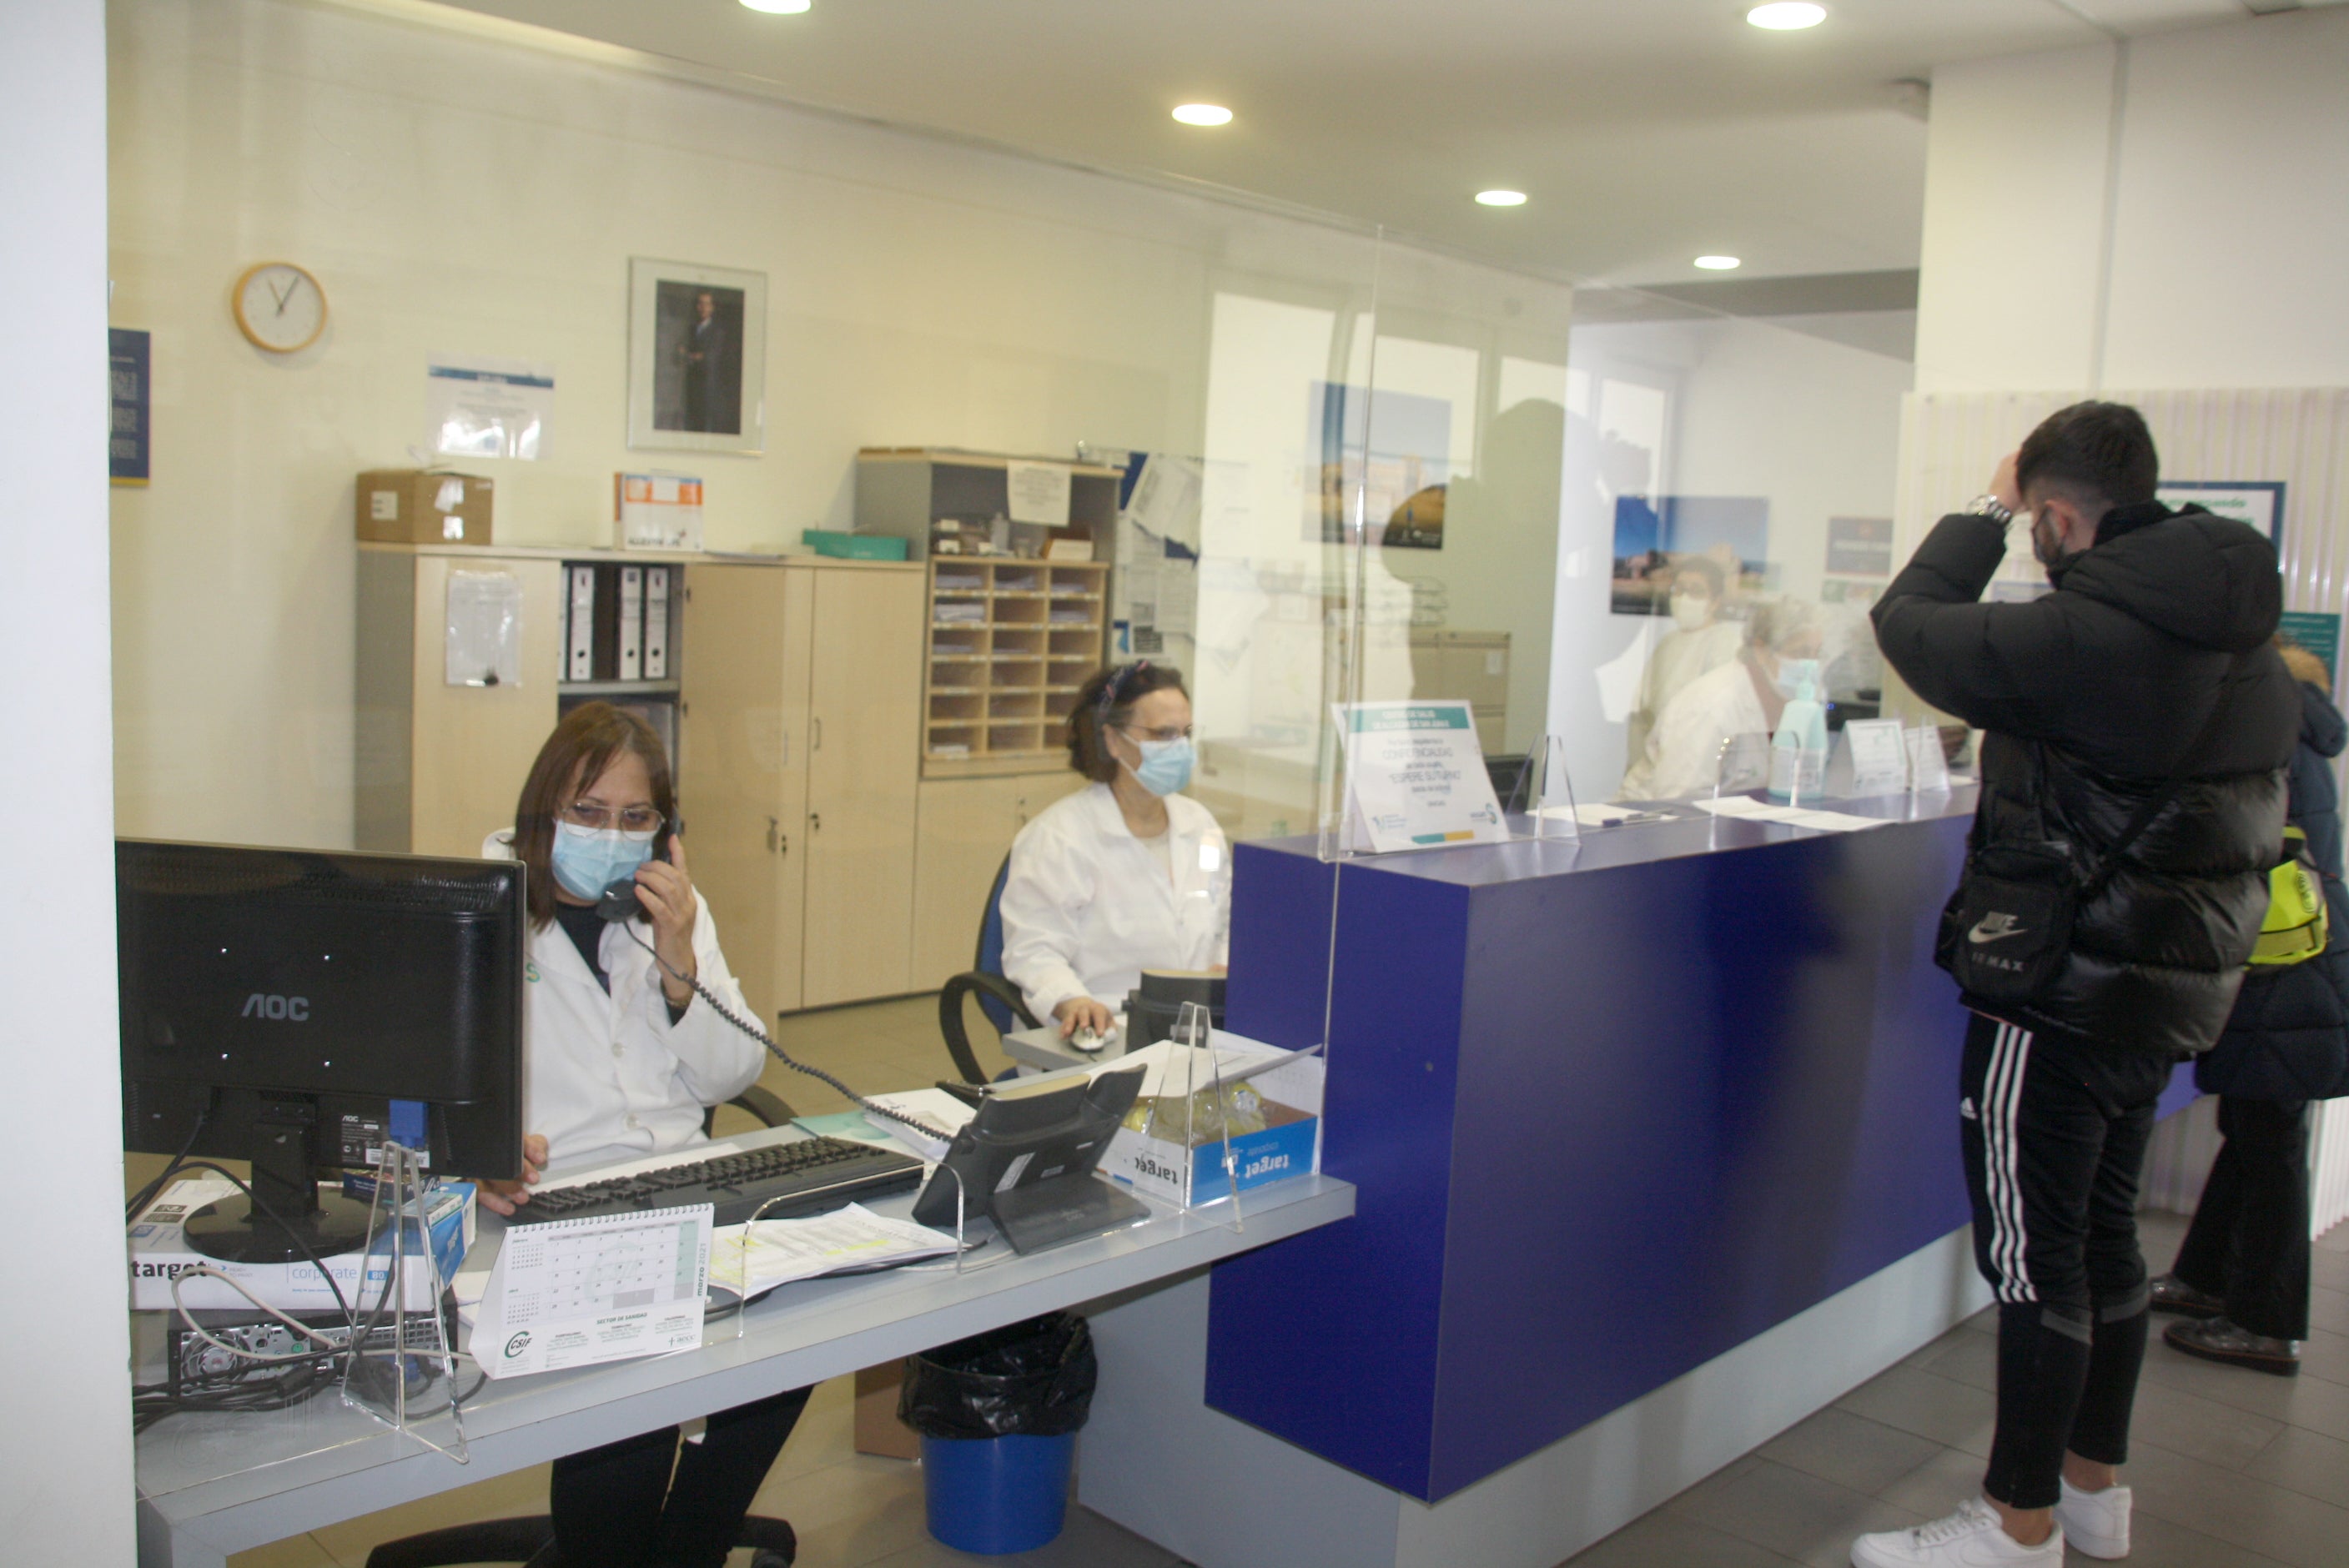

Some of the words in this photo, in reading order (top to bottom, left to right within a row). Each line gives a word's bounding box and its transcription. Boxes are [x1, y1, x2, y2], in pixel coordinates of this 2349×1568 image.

[241, 993, 309, 1022] AOC
[342, 1114, 359, 1123] AOC
[1245, 1154, 1289, 1179] target
[698, 1243, 707, 1264] 2021
[131, 1259, 209, 1280] target
[292, 1267, 357, 1280] corprate
[511, 1337, 533, 1349] CSIF
